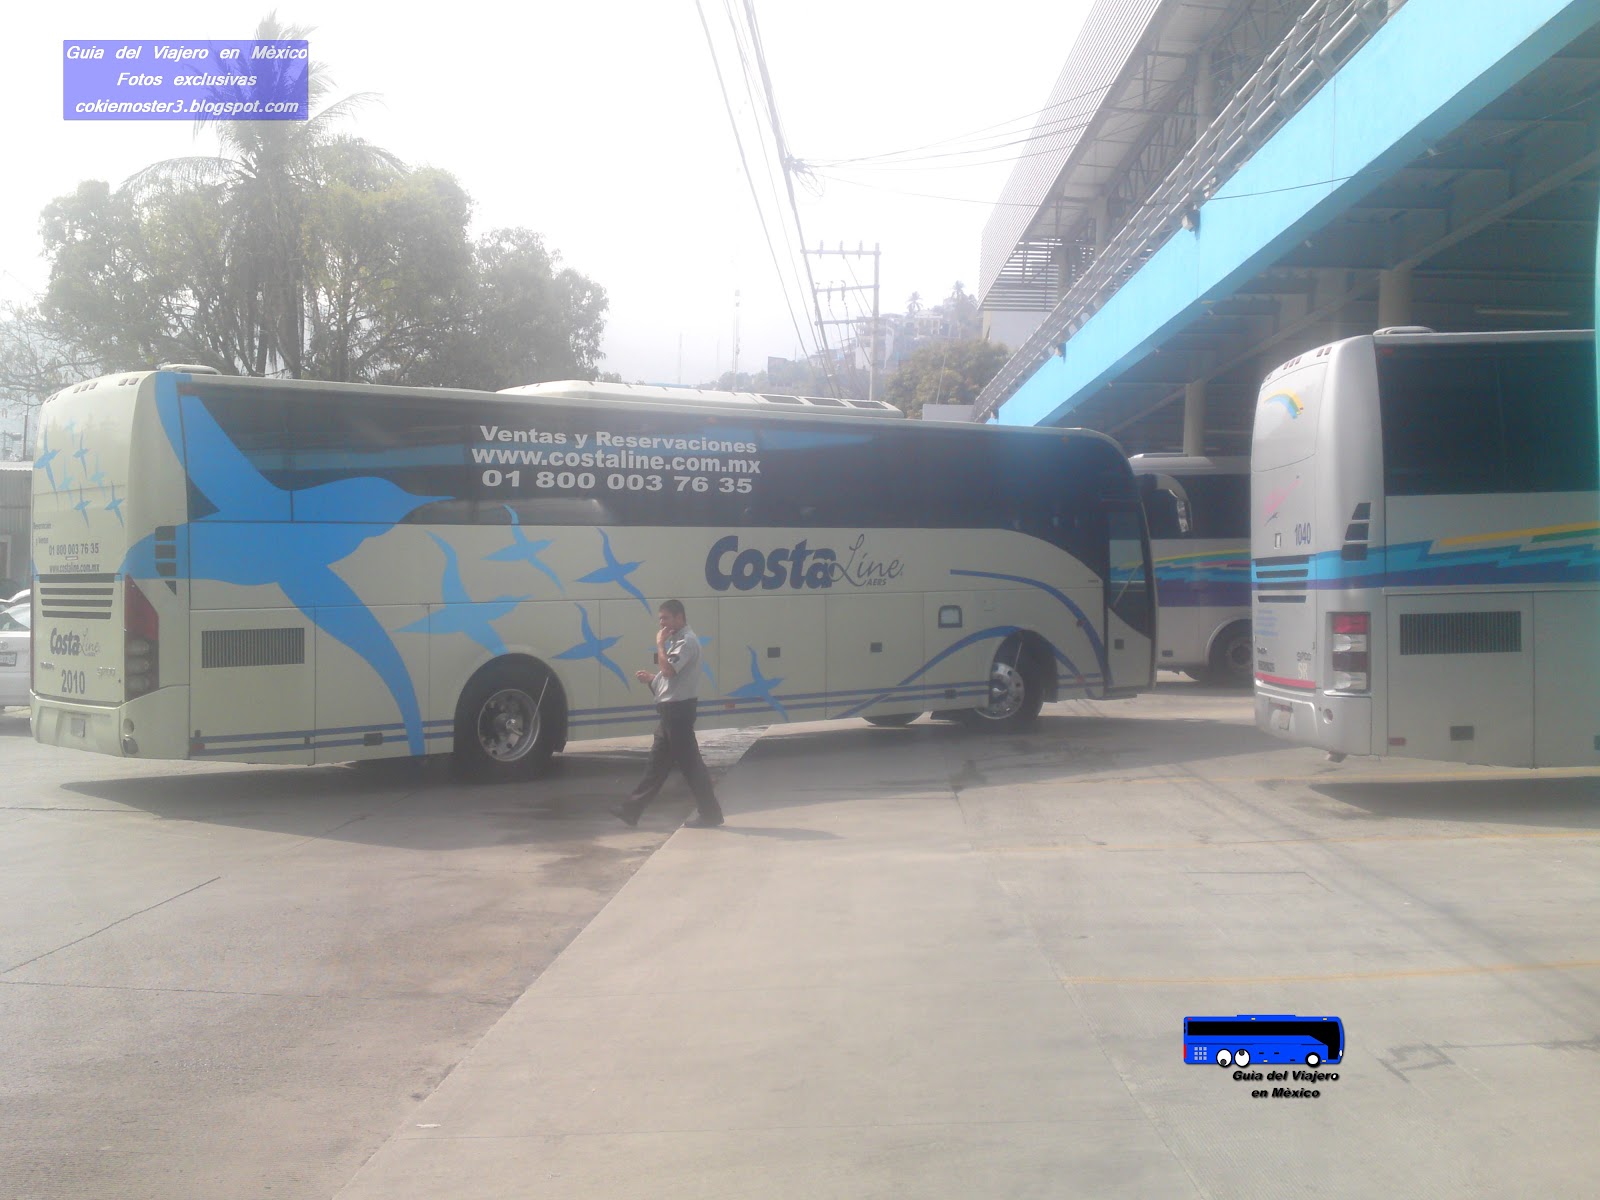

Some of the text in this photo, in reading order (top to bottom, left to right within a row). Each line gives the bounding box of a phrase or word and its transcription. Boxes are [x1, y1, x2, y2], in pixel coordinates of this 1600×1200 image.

[480, 425, 758, 453] Ventas y Reservaciones
[471, 448, 761, 474] www.costaline.com.mx
[482, 469, 753, 494] 01 800 003 76 35
[1294, 522, 1311, 545] 1040
[67, 543, 79, 555] 003
[80, 543, 89, 554] 76
[90, 542, 100, 554] 35
[705, 533, 904, 592] Costa Line
[866, 578, 887, 586] AERS
[50, 627, 80, 656] Costa
[61, 669, 85, 694] 2010
